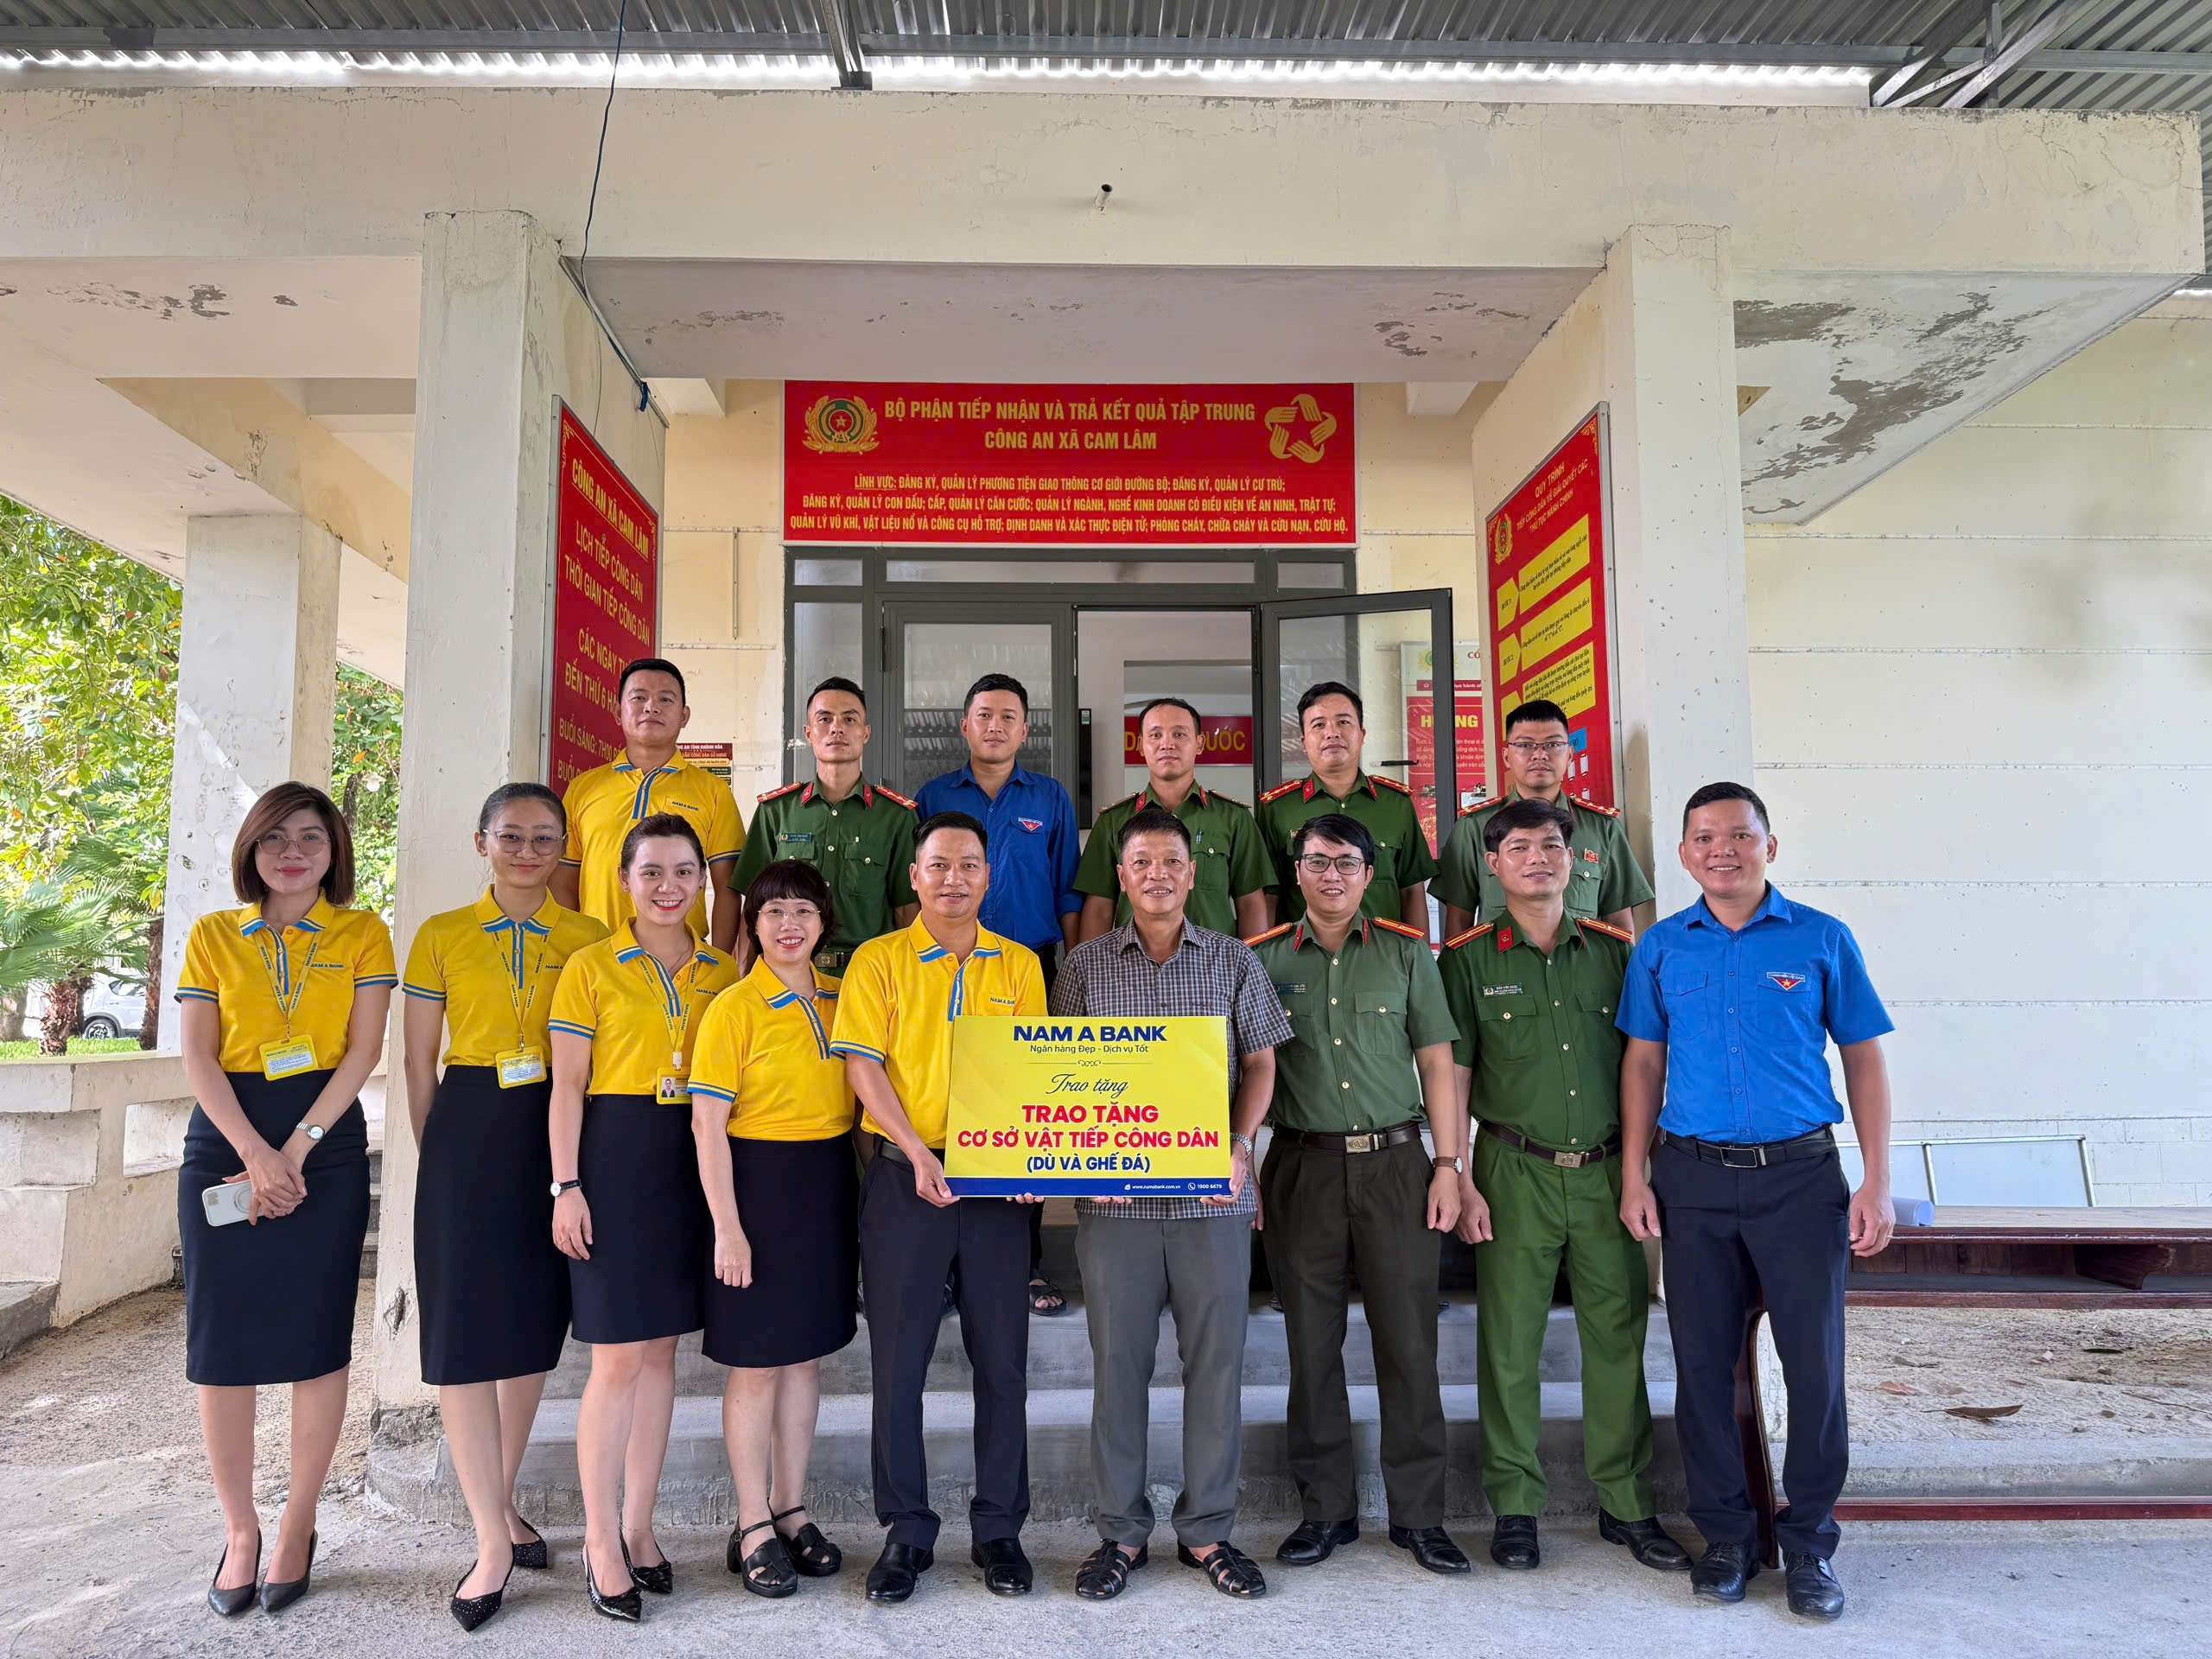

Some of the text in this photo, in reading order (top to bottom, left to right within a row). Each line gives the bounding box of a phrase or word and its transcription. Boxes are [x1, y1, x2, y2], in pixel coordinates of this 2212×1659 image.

[886, 397, 1255, 423] BỘ PHẬN TIẾP NHẬN VÀ TRẢ KẾT QUẢ TẬP TRUNG
[985, 429, 1156, 448] CÔNG AN XÃ CAM LÂM
[855, 474, 874, 490] LĨNH
[877, 476, 896, 491] VỰC:
[899, 474, 922, 488] ĐĂNG
[925, 475, 938, 489] KÝ,
[942, 474, 964, 490] QUẢN
[980, 477, 1014, 490] PHƯƠNG
[1018, 476, 1036, 492] TIỆN
[1039, 478, 1058, 490] GIAO
[1061, 476, 1089, 490] THÔNG
[1105, 477, 1122, 490] GIỚI
[1125, 476, 1154, 490] ĐƯỜNG
[1157, 477, 1170, 493] BỘ;
[1173, 477, 1196, 490] ĐĂNG
[1199, 477, 1211, 491] KÝ,
[1215, 476, 1237, 492] QUẢN
[1267, 477, 1285, 491] TRÚ;
[572, 458, 648, 559] CÔNG AN XÃ CAM LÂM
[804, 493, 827, 507] ĐĂNG
[830, 494, 842, 508] KÝ,
[846, 493, 869, 509] QUẢN
[885, 497, 902, 509] CON
[906, 493, 925, 510] DẤU;
[928, 495, 946, 510] CẤP,
[949, 494, 972, 511] QUẢN
[988, 497, 1005, 510] CĂN
[1007, 497, 1033, 511] CƯỚC;
[1036, 495, 1058, 512] QUẢN
[1074, 497, 1105, 511] NGÀNH,
[1109, 496, 1131, 511] NGHỀ
[1134, 499, 1154, 511] KINH
[1157, 499, 1185, 511] DOANH
[1202, 496, 1221, 511] ĐIỀU
[1224, 498, 1243, 513] KIỆN
[1274, 499, 1297, 512] NINH,
[1300, 498, 1319, 513] TRẬT
[1323, 499, 1335, 513] TỰ;
[791, 512, 814, 529] QUẢN
[843, 515, 860, 530] KHÍ,
[863, 515, 879, 531] VẬT
[881, 515, 899, 531] LIỆU
[931, 516, 954, 530] CÔNG
[985, 518, 1003, 532] TRỢ;
[1007, 519, 1027, 532] ĐỊNH
[1030, 519, 1052, 531] DANH
[1069, 518, 1085, 531] XÁC
[1089, 518, 1109, 533] THỰC
[1113, 518, 1133, 533] ĐIỆN
[1135, 516, 1147, 532] TỬ;
[1151, 518, 1179, 531] PHÒNG
[1182, 519, 1205, 532] CHÁY,
[1208, 518, 1230, 531] CHỮA
[1233, 518, 1255, 531] CHÁY
[1271, 518, 1288, 531] CỨU
[1291, 520, 1311, 533] NẠN,
[1314, 518, 1331, 531] CỨU
[1334, 518, 1347, 533] HỘ.
[576, 520, 643, 602] LỊCH TIẾP CÔNG DÂN
[565, 554, 650, 647] THỜI GIAN TIẾP CÔNG DÂN
[578, 627, 595, 659] CÁC
[597, 642, 617, 675] NGÀY
[565, 658, 582, 692] ĐẾN
[585, 676, 601, 704] THỨ
[601, 687, 606, 709] 6
[560, 713, 575, 743] BUỔI
[577, 726, 597, 754] SÁNG:
[1202, 726, 1245, 751] ƯỚC
[1014, 1026, 1167, 1041] NAM A BANK
[1031, 1045, 1052, 1053] Ngân
[1055, 1045, 1076, 1053] hàng
[1078, 1045, 1095, 1053] Đẹp
[1103, 1045, 1122, 1053] Dịch
[1135, 1044, 1148, 1052] Tốt
[1046, 1073, 1128, 1098] Trao tặng
[1022, 1102, 1159, 1127] TRAO TẶNG
[958, 1125, 1218, 1152] CƠ SỞ VẬT TIẾP CÔNG DÂN
[1027, 1152, 1150, 1173] (DÙ VÀ GHẾ ĐÁ)
